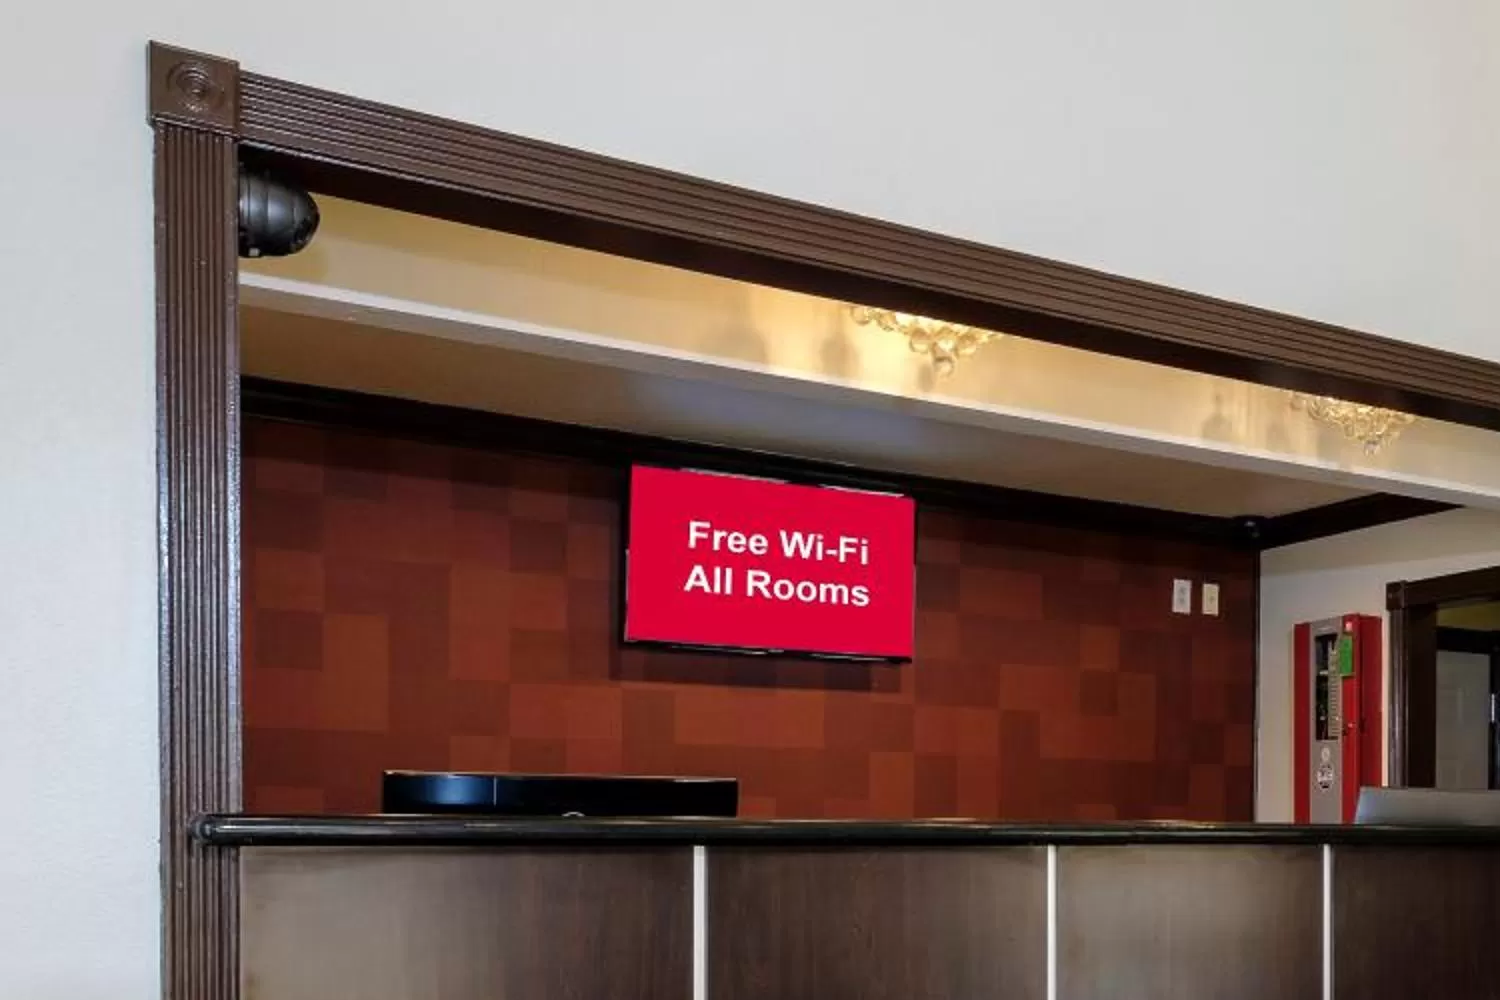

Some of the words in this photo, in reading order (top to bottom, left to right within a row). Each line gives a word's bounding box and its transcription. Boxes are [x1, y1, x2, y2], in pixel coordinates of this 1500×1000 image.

[687, 519, 769, 556] Free
[779, 529, 870, 566] Wi-Fi
[683, 564, 734, 596] All
[746, 568, 871, 608] Rooms
